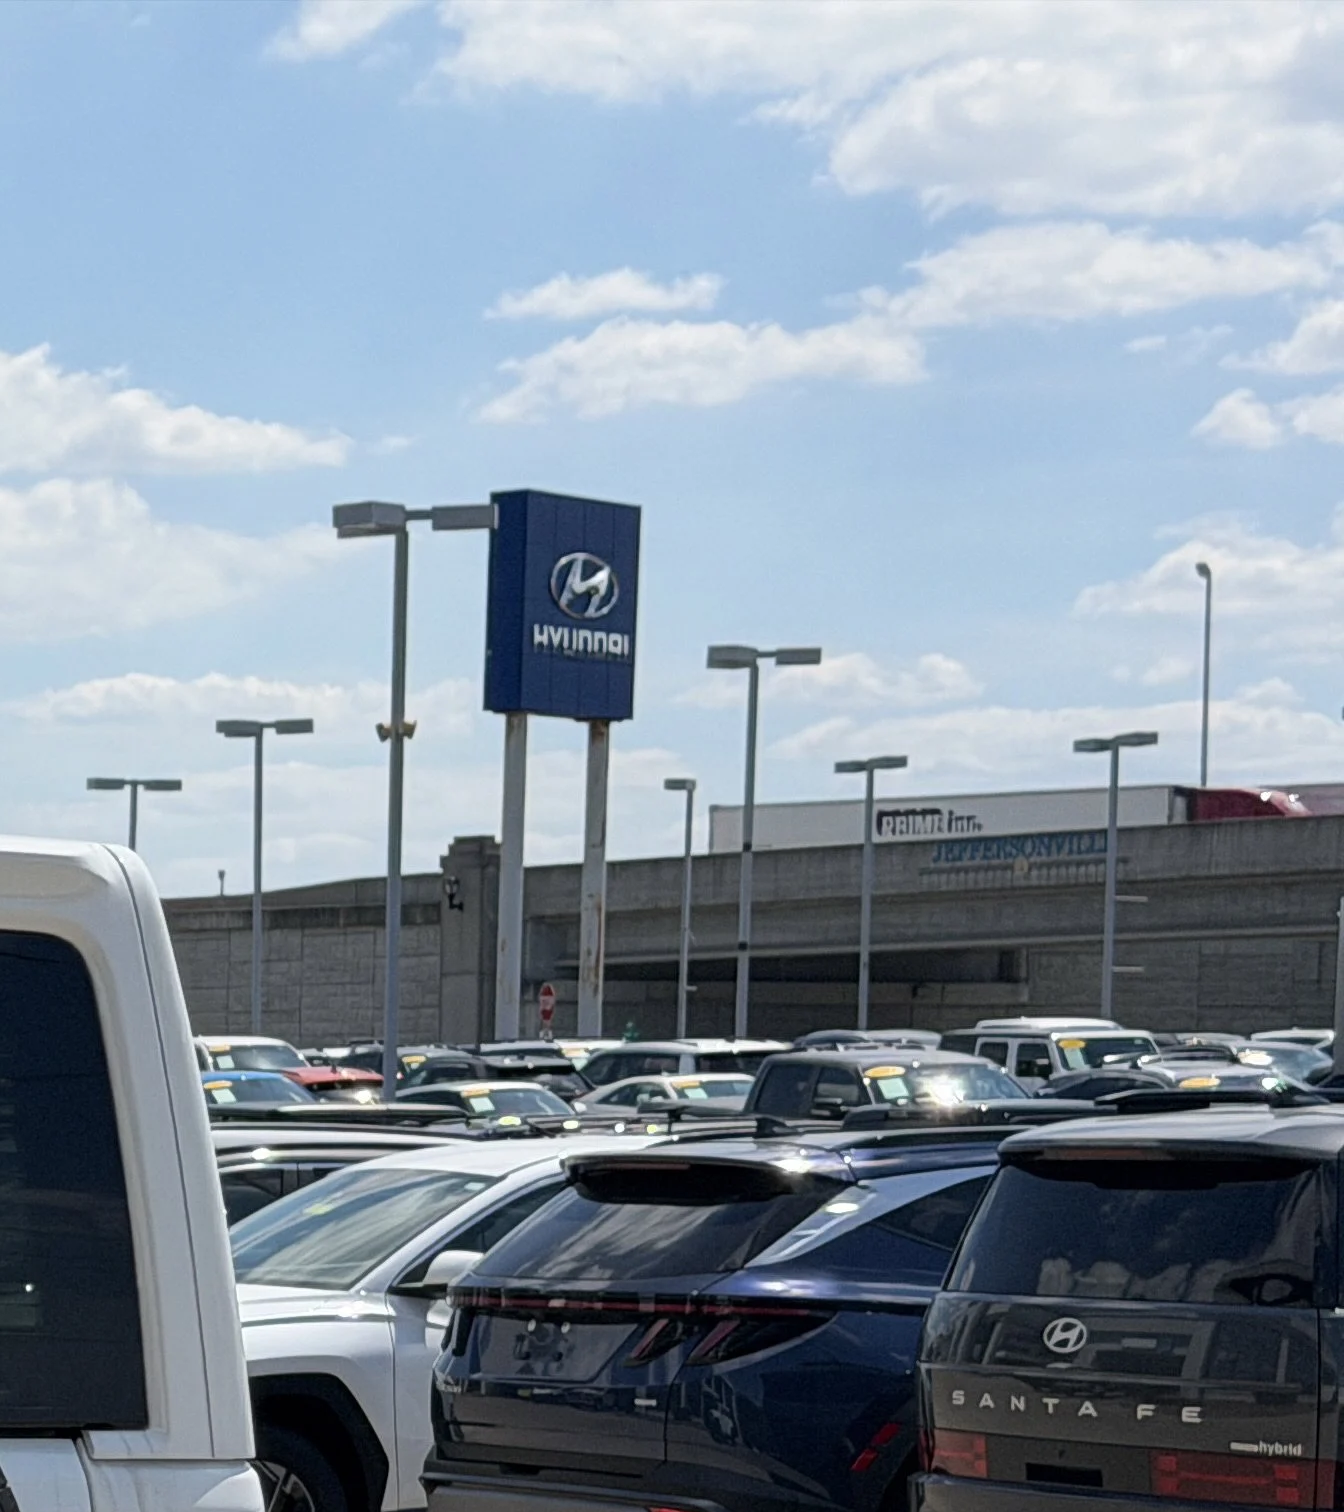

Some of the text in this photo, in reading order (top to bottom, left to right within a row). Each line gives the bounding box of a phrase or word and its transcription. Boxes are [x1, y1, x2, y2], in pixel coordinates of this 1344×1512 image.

[533, 623, 630, 657] HYUNDAI
[879, 811, 944, 836] PRIME
[951, 1390, 1204, 1423] SANTA FE
